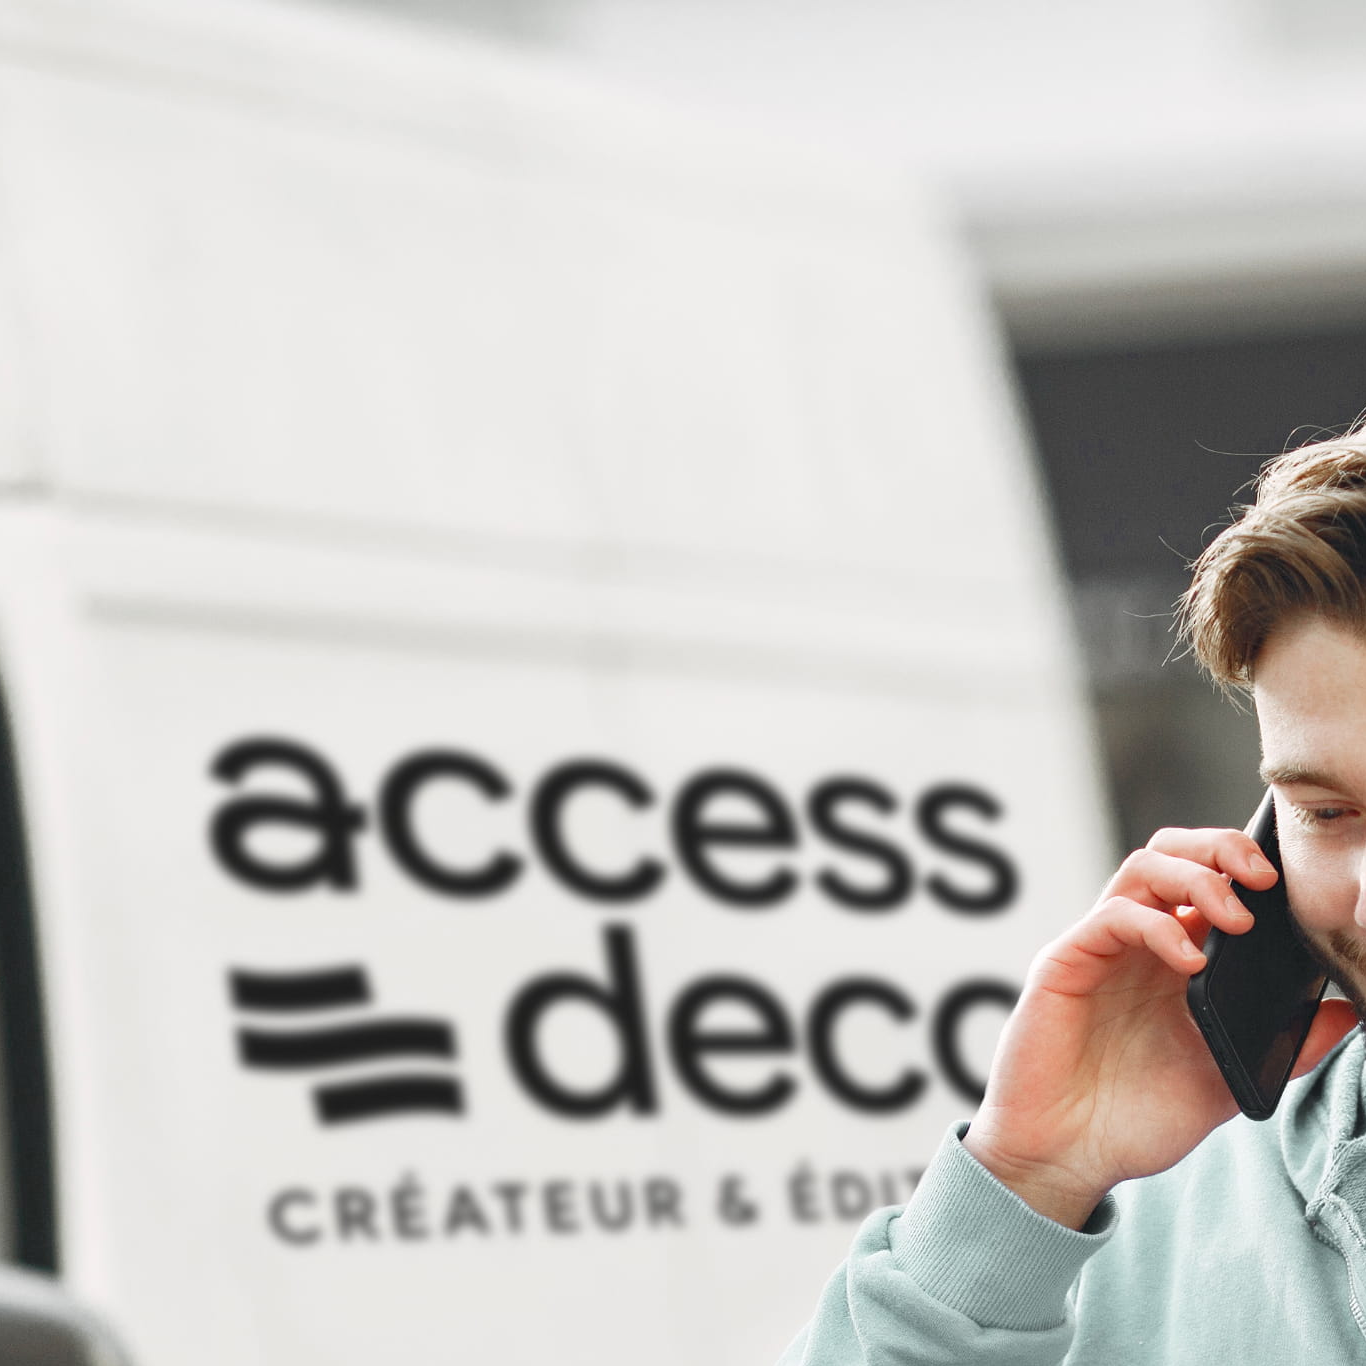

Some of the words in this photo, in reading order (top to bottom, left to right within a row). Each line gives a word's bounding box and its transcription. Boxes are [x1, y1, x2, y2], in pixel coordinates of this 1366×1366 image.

[207, 734, 1022, 916] access
[265, 1167, 686, 1249] CRÉATEUR
[716, 1172, 759, 1228] &
[785, 1158, 928, 1224] ÉDI
